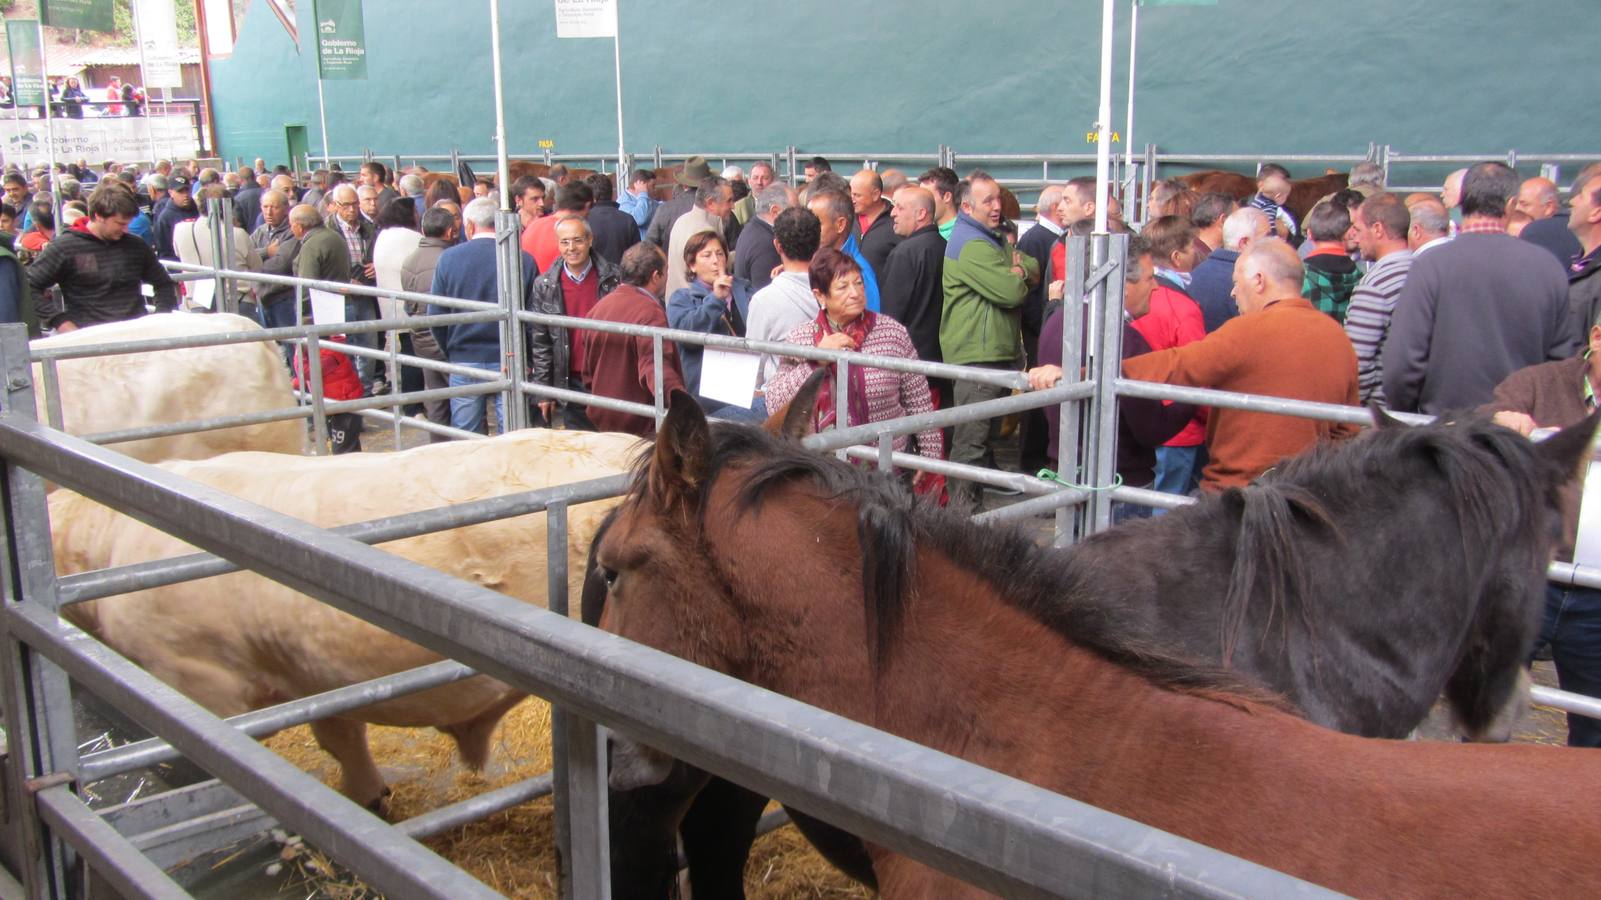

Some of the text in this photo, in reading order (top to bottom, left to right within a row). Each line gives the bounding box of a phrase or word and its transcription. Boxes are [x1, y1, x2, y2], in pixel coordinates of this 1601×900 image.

[321, 39, 357, 47] Gobierno
[334, 47, 344, 55] La
[345, 47, 365, 56] Rioja
[1086, 131, 1120, 143] FAA
[61, 145, 73, 153] La
[75, 144, 100, 154] Rioja
